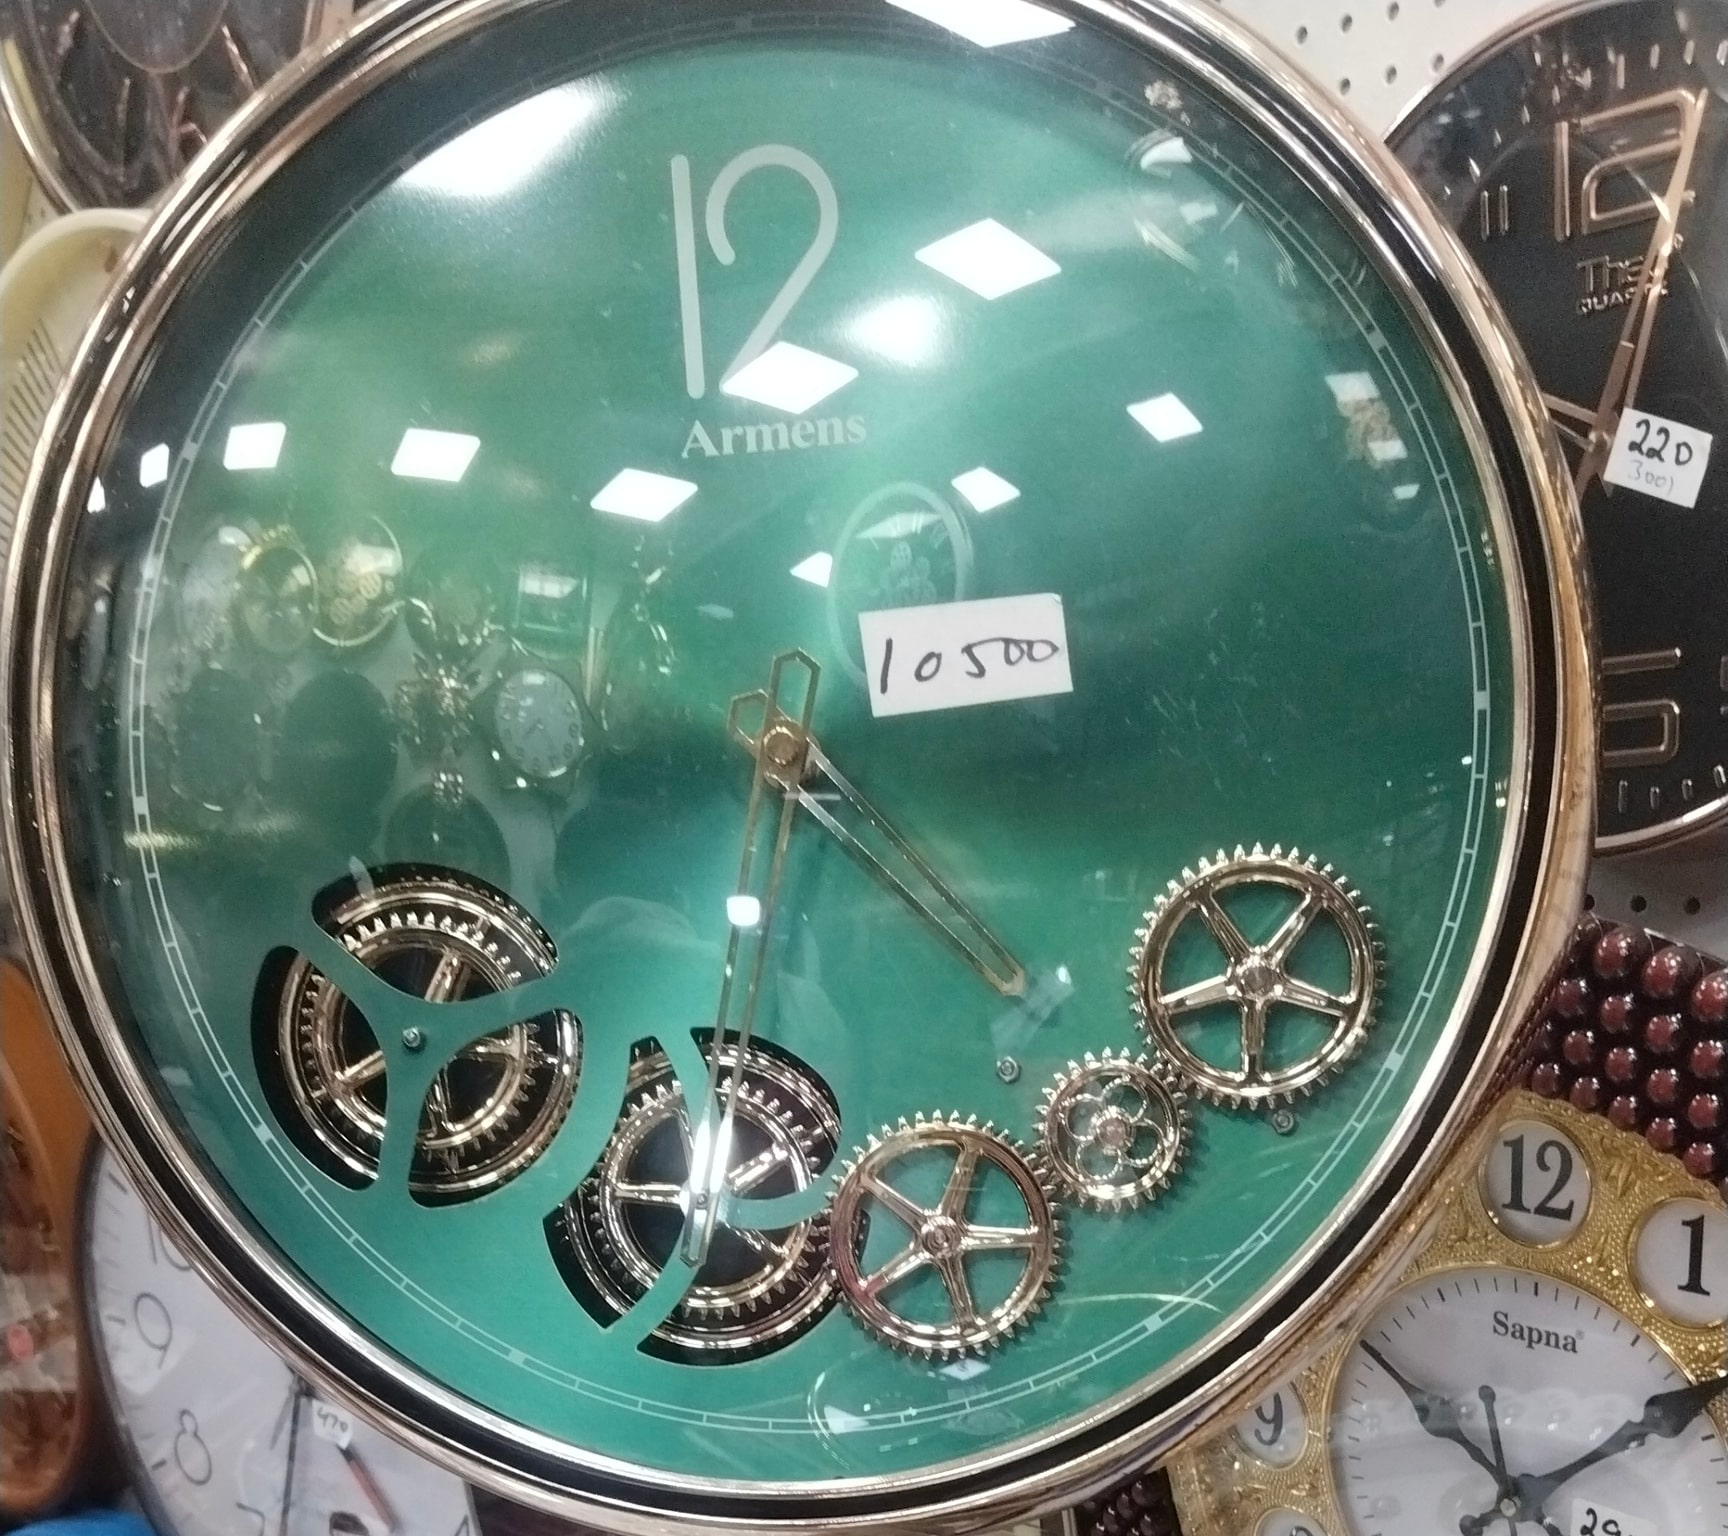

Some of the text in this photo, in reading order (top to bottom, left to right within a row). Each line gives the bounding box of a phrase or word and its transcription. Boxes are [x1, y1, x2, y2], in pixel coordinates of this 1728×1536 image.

[671, 144, 838, 399] 12
[681, 414, 867, 459] Armens
[1628, 418, 1693, 466] 220
[880, 637, 1060, 694] 10500
[1502, 1134, 1575, 1222] 12
[1677, 1214, 1710, 1297] 1
[134, 1292, 172, 1370] 9
[174, 1408, 212, 1486] 8
